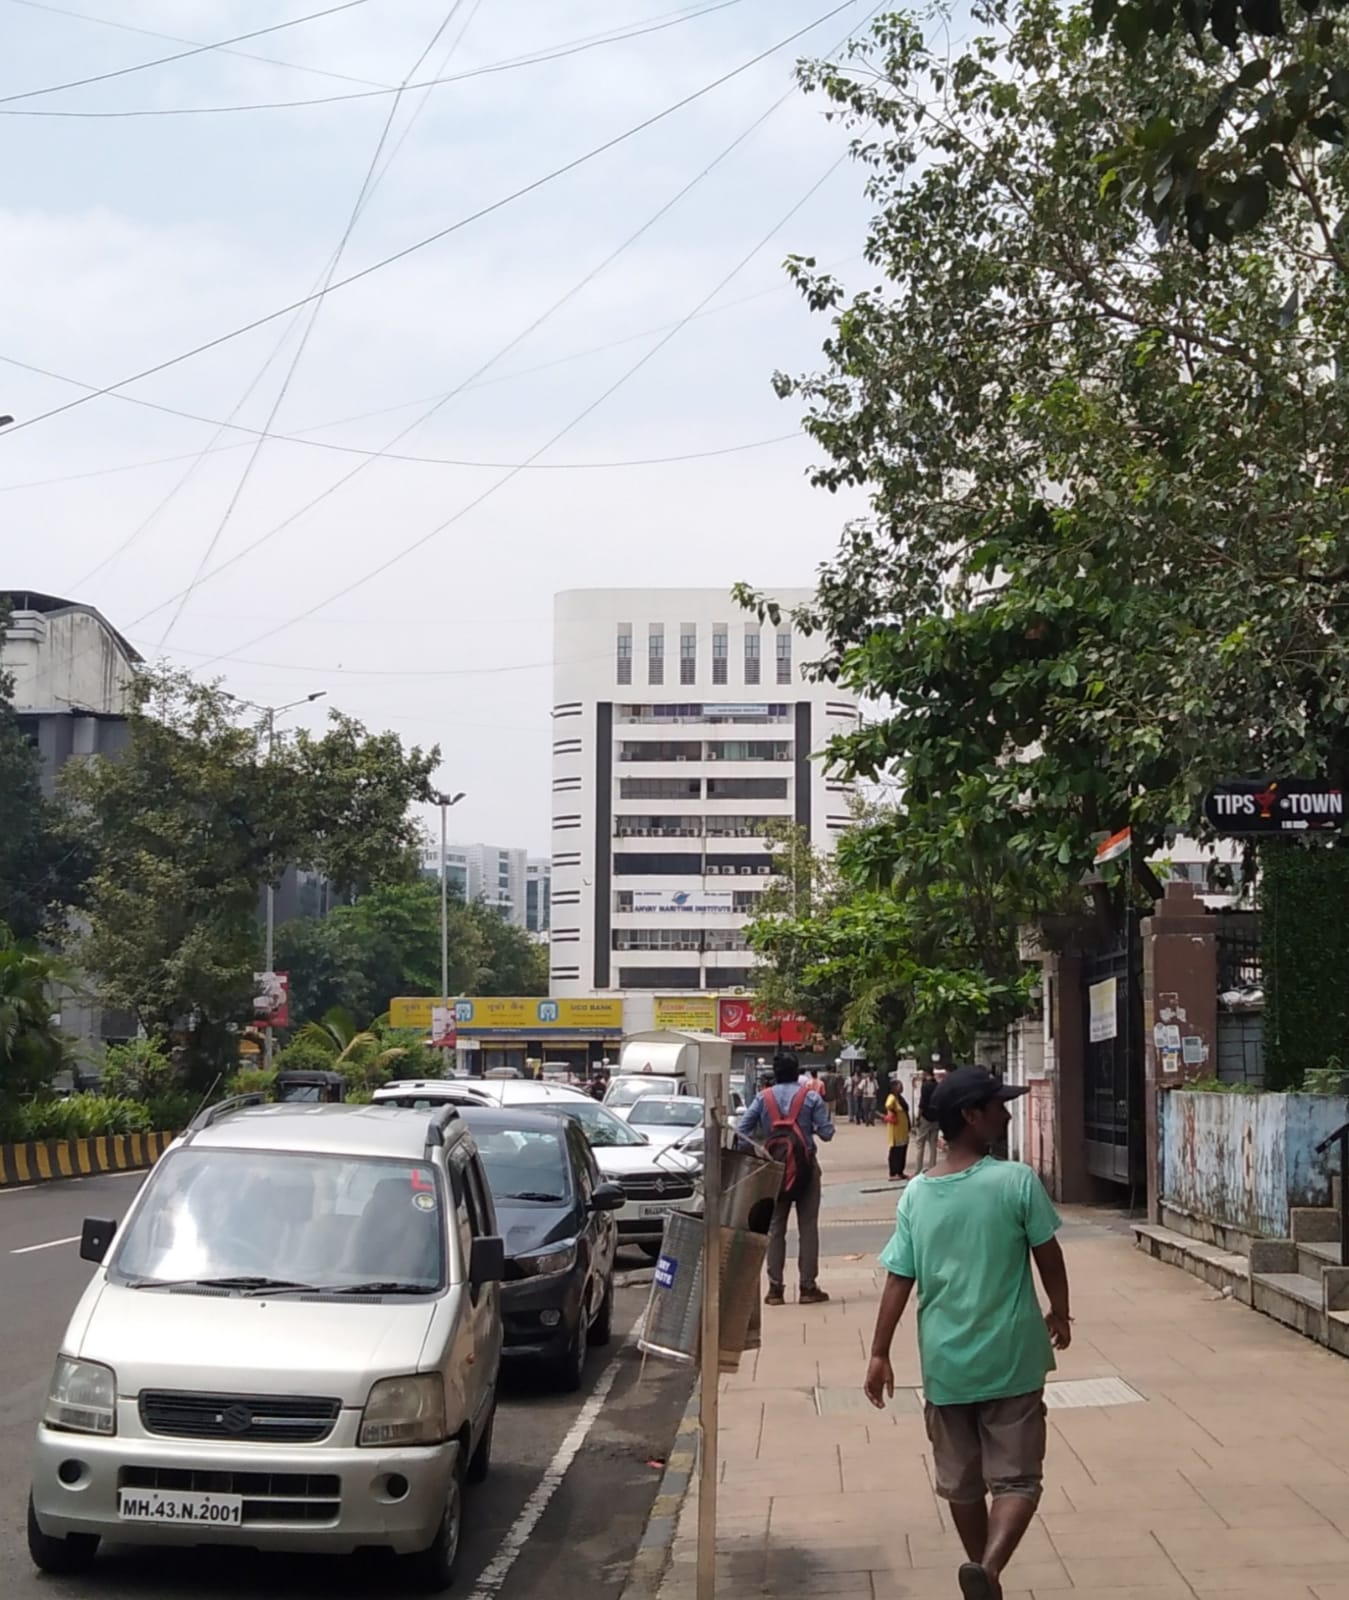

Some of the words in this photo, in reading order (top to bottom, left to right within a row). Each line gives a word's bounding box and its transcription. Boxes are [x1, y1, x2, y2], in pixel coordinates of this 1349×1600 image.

[1288, 794, 1343, 814] TOWN
[659, 905, 693, 913] MARITIME
[694, 905, 731, 913] INSTITUTE
[123, 1499, 240, 1522] MH.43.N.2001
